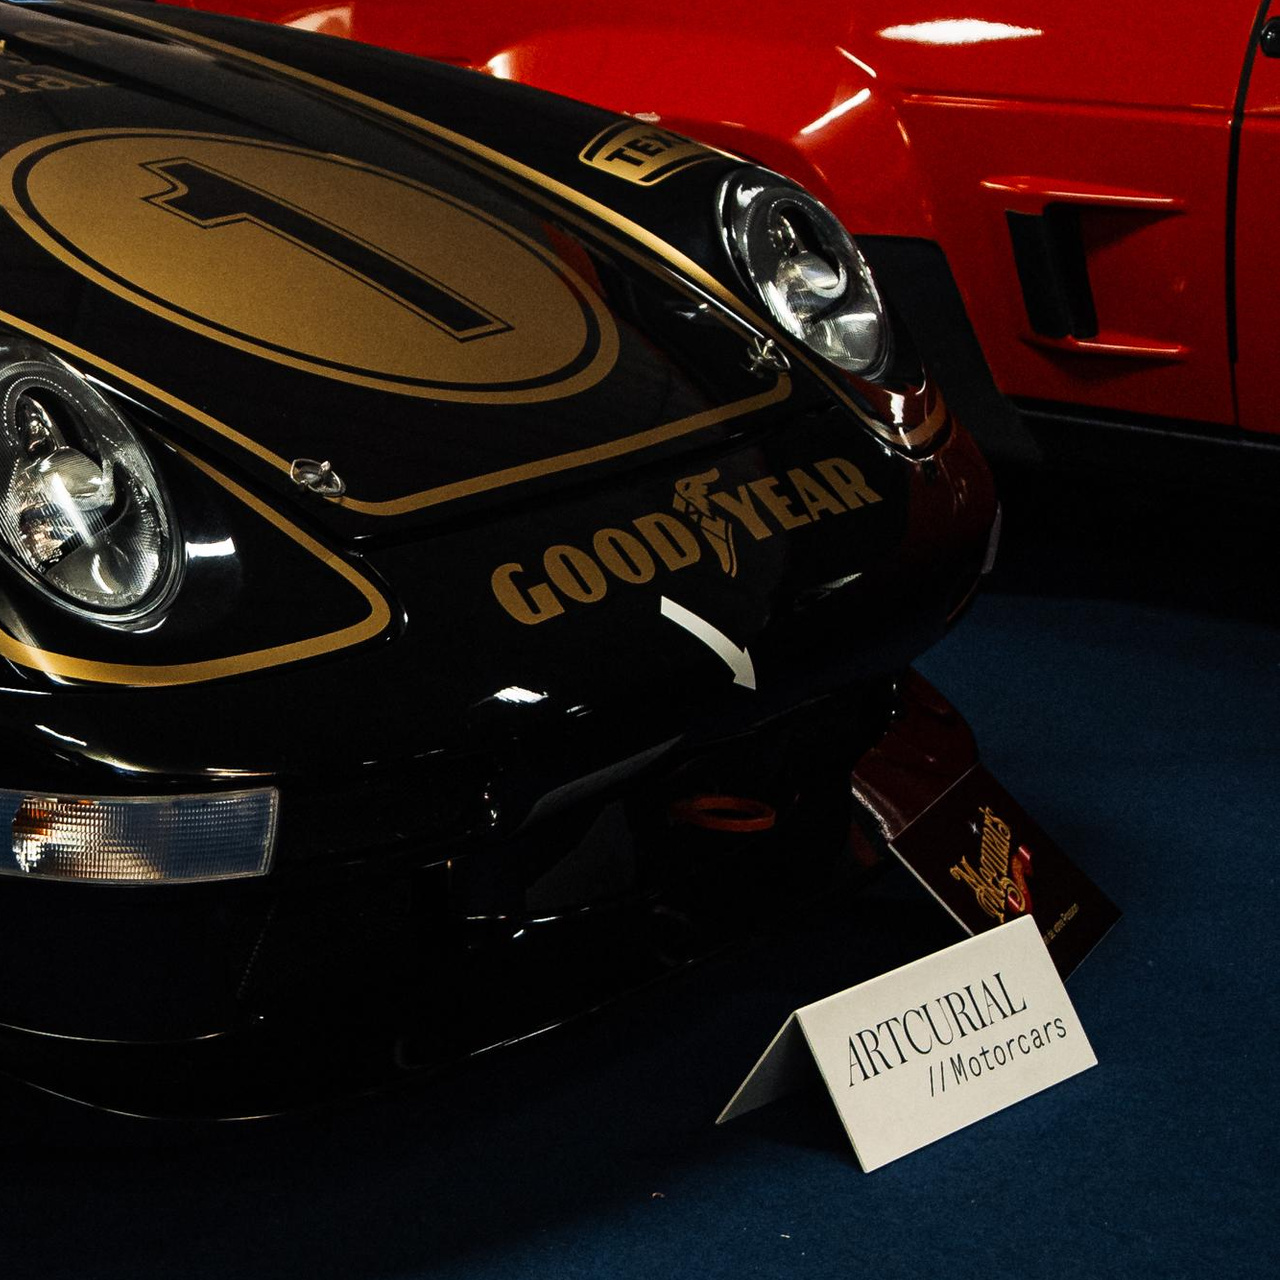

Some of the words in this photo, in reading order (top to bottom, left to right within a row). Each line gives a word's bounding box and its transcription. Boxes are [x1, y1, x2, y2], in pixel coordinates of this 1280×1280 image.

[138, 157, 515, 343] 1
[490, 457, 883, 626] GOODYEAR
[849, 972, 1028, 1087] ARTCURIAL
[928, 1017, 1068, 1098] //Motorcars
